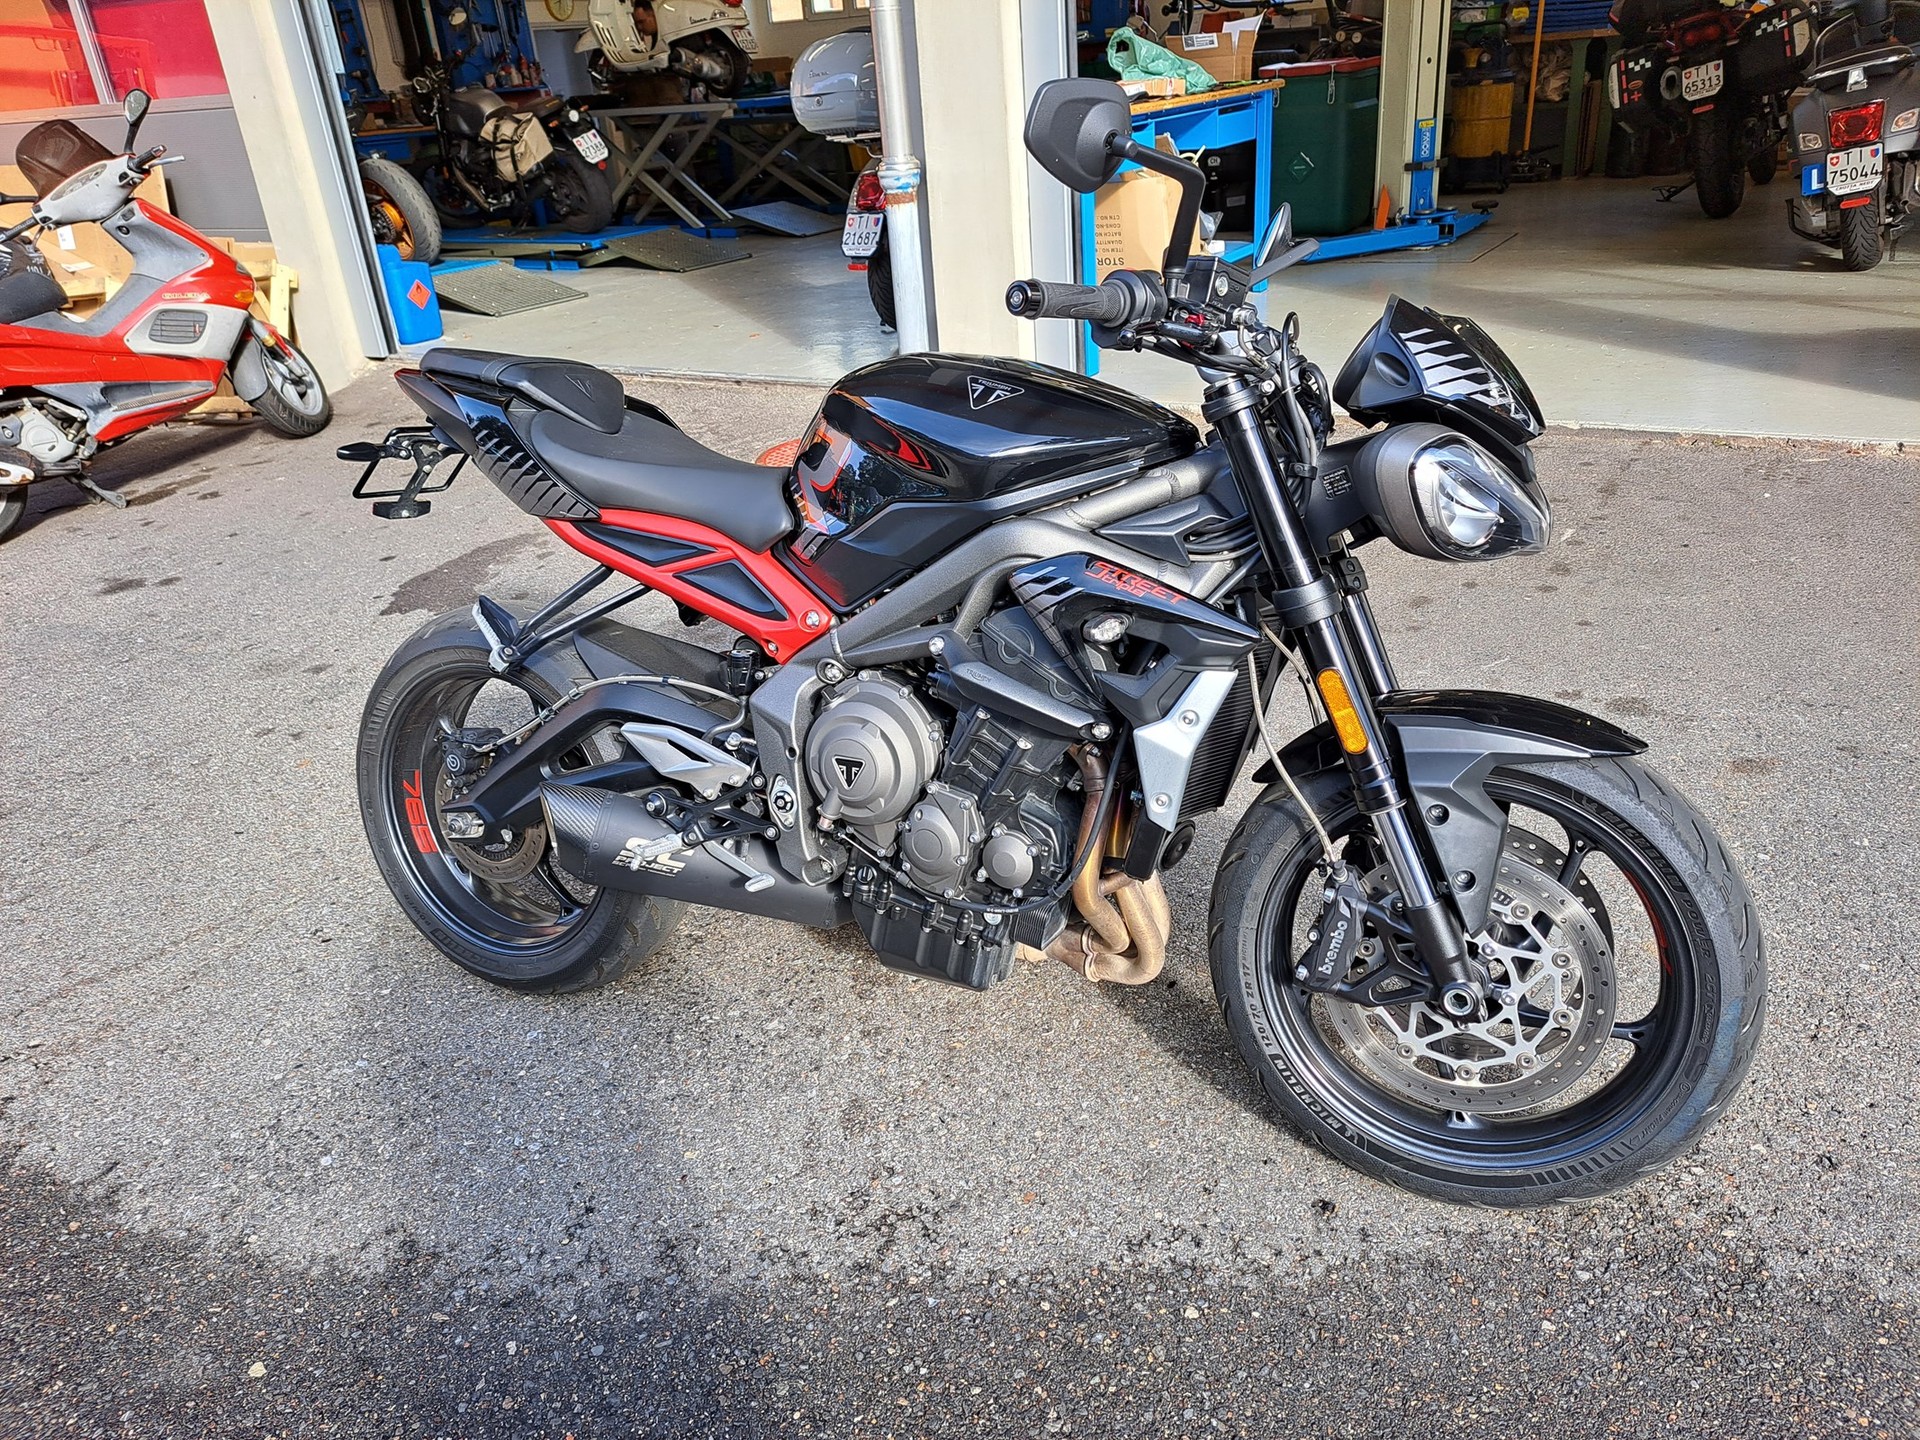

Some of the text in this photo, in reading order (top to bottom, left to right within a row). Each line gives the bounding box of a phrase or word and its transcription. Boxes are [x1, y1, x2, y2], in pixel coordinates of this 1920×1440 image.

[1694, 64, 1709, 79] TI
[1684, 74, 1721, 94] 65313
[1843, 149, 1863, 166] TI
[1811, 168, 1825, 190] L
[1829, 163, 1880, 186] 75044
[858, 215, 870, 229] TI
[844, 231, 878, 246] 21687
[979, 379, 1012, 391] TRIUMPH
[1085, 561, 1188, 605] STREET
[403, 769, 438, 853] 765
[1681, 899, 1710, 958] POWER
[1318, 920, 1348, 975] brembo
[1242, 962, 1251, 978] 17
[1245, 981, 1254, 998] ZR
[1249, 1003, 1273, 1048] 120/70
[1274, 1059, 1342, 1129] MICHELIN
